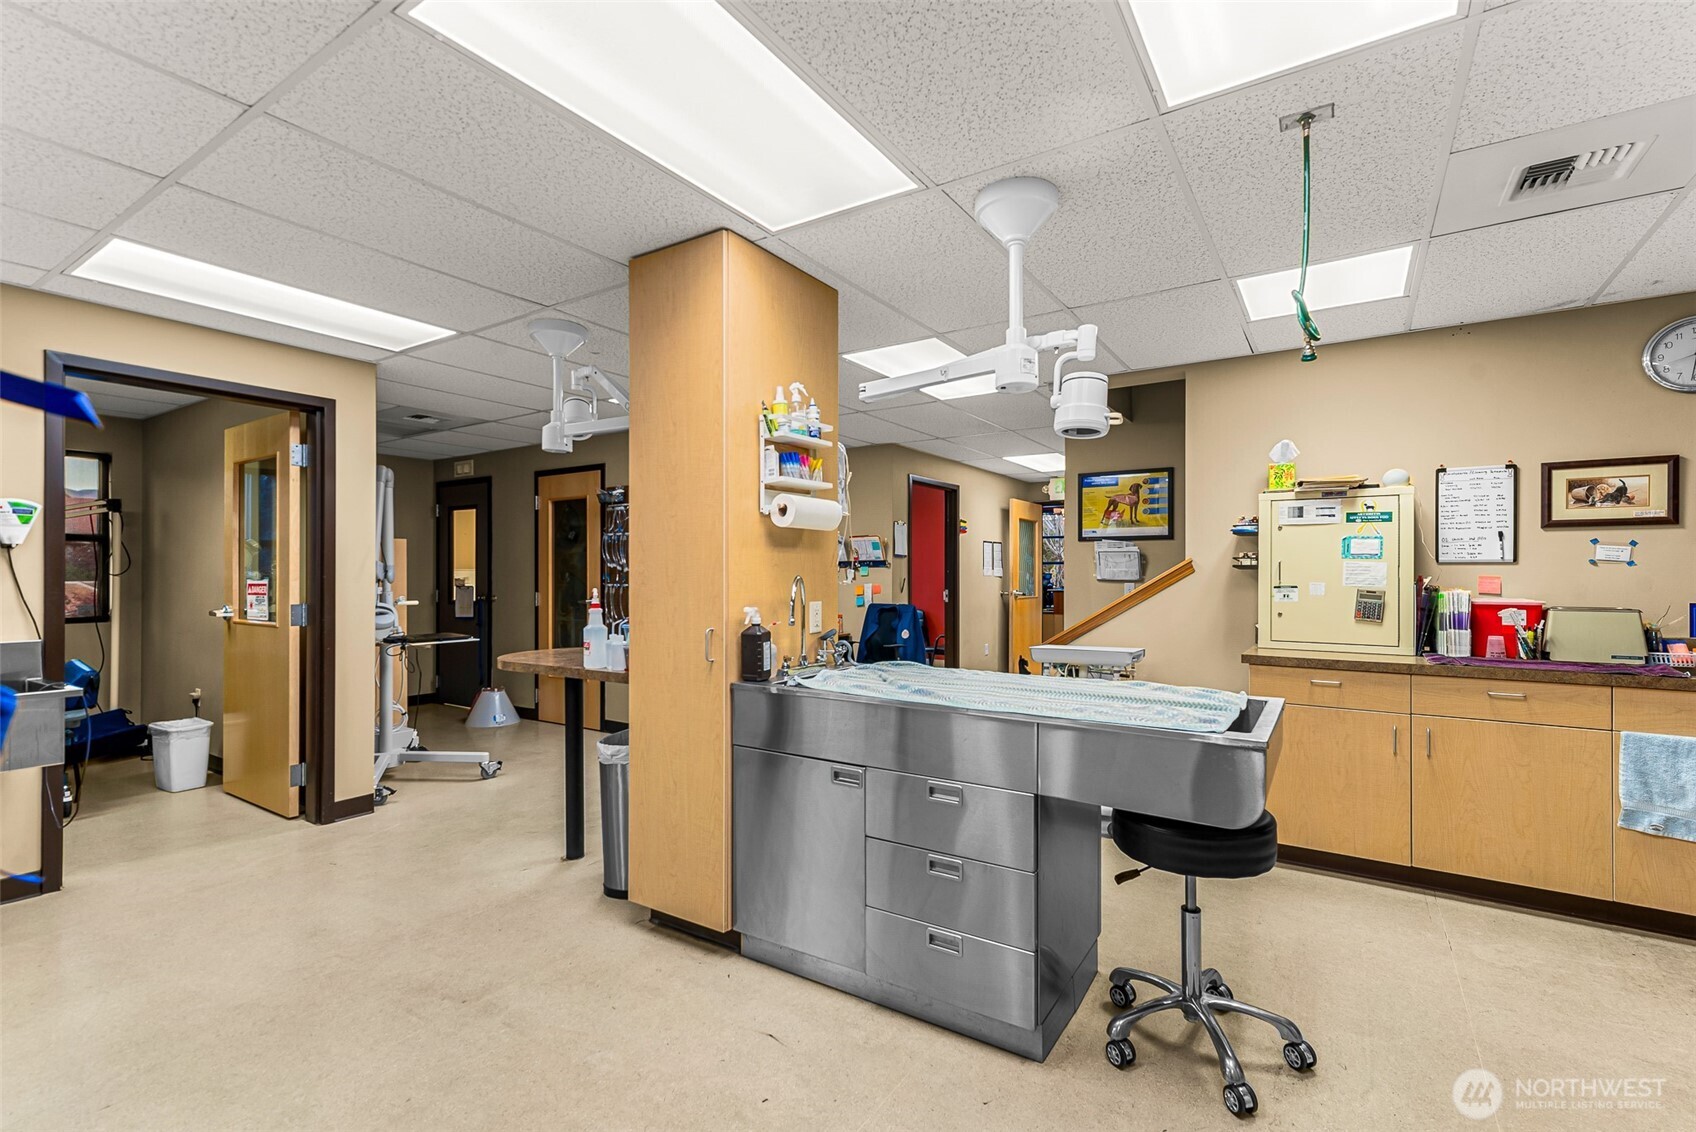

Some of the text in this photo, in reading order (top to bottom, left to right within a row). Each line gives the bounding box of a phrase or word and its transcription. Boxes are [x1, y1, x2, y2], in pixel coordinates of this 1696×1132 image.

[1675, 332, 1683, 340] 11
[1664, 341, 1673, 349] 10
[1676, 372, 1683, 380] 7
